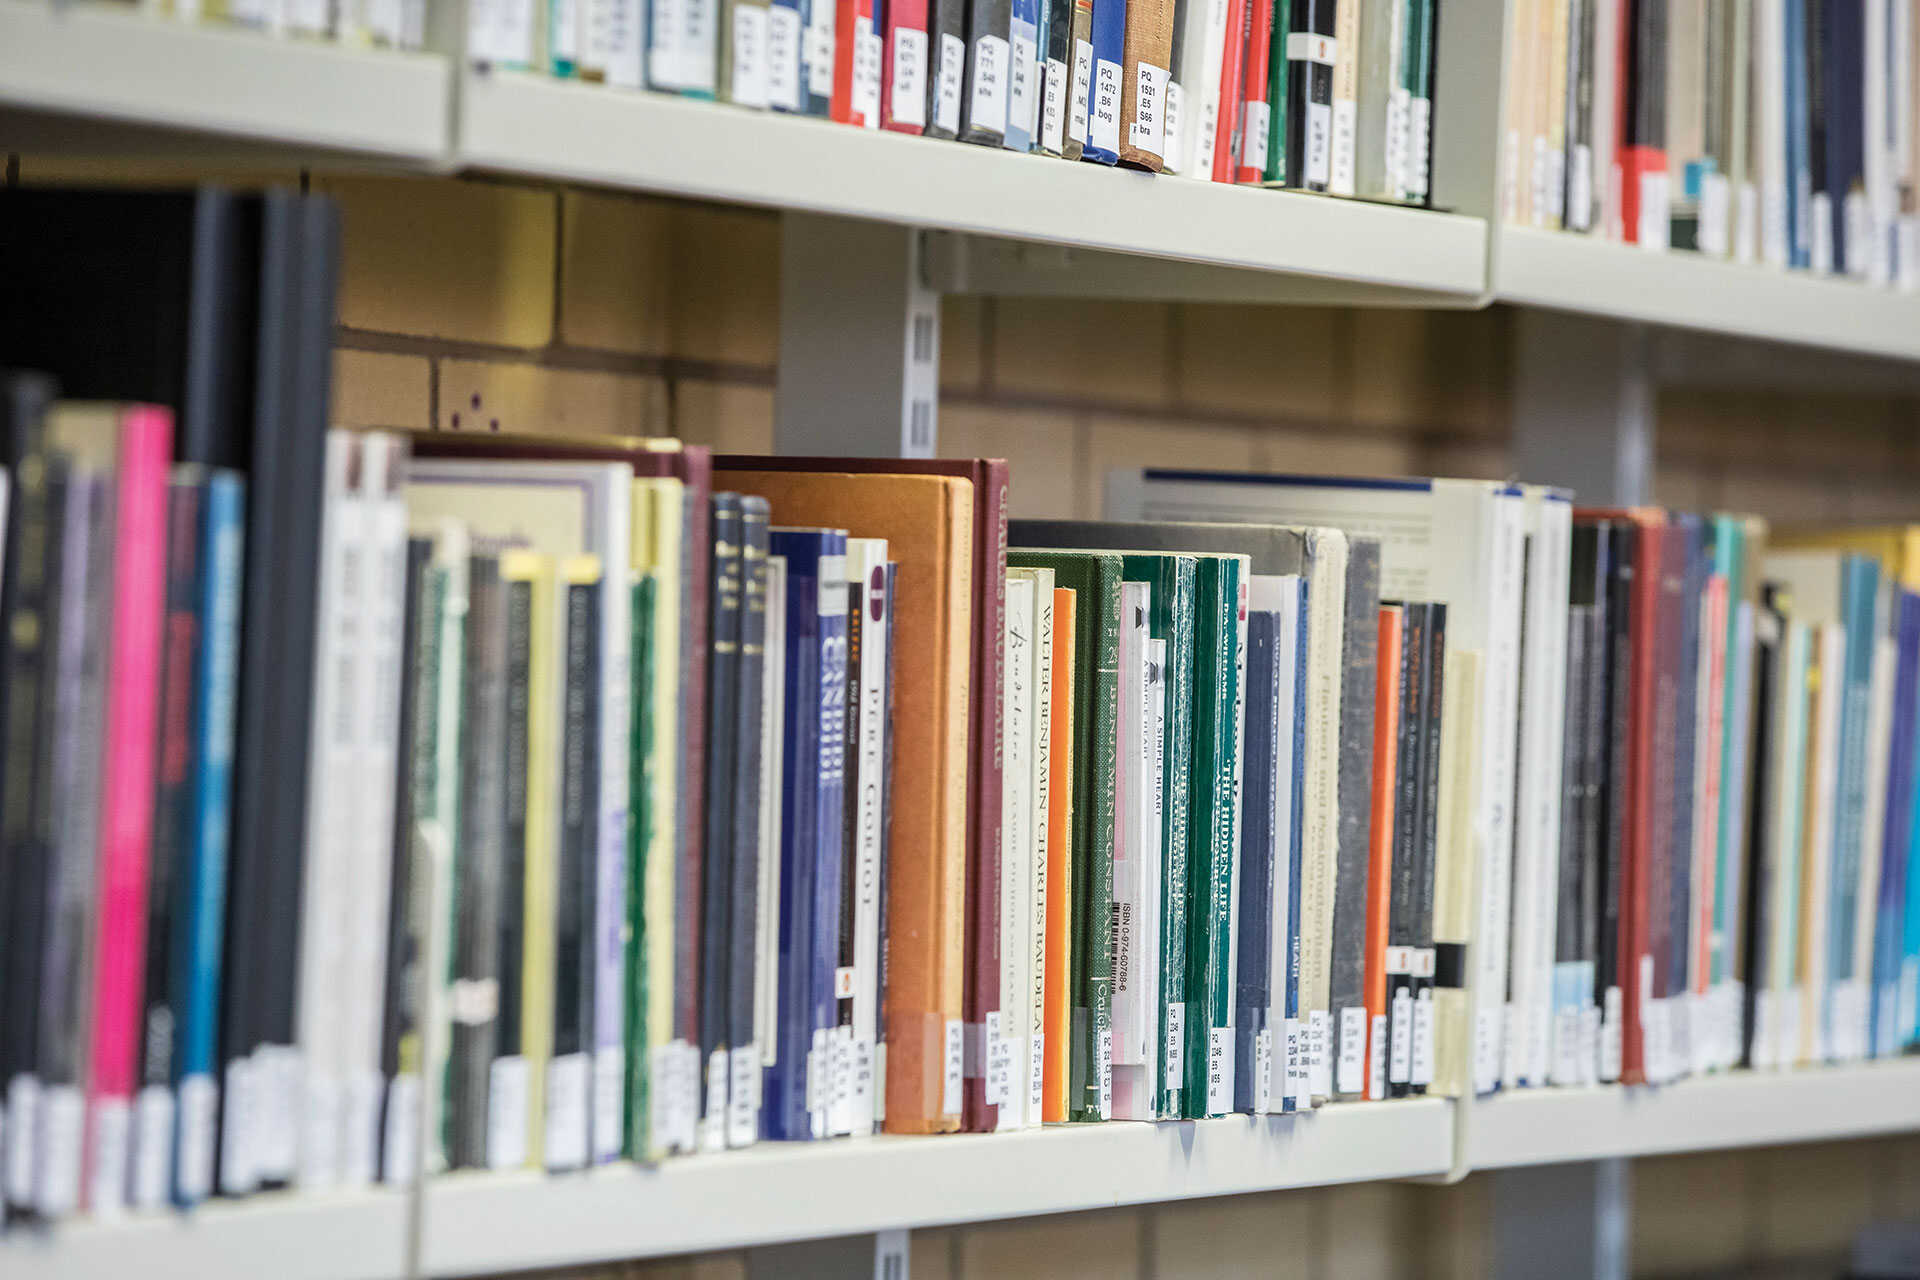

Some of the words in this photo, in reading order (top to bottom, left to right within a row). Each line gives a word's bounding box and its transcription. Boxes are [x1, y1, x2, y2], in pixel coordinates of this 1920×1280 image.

[1048, 61, 1057, 73] PQ
[1079, 57, 1088, 70] PQ
[1100, 67, 1113, 80] PQ
[1141, 70, 1152, 82] PQ
[1099, 81, 1117, 95] 1472
[1099, 95, 1112, 107] .B6
[1140, 84, 1156, 97] 1521
[1098, 109, 1113, 124] bog
[1139, 124, 1151, 136] bra
[996, 485, 1008, 600] CHARLES
[1041, 605, 1052, 694] WALTER
[1221, 630, 1229, 700] WILLIAMS
[994, 605, 1006, 770] BAUDELAIRE
[1320, 675, 1331, 760] Flaubert
[1038, 700, 1049, 810] BENJAMIN
[1107, 685, 1118, 817] BENJAMIN
[1154, 776, 1162, 816] HEART
[1318, 769, 1328, 808] and
[1220, 806, 1230, 875] HIDDEN
[1036, 822, 1047, 926] CHARLES
[1103, 823, 1113, 961] CONSTANT
[1121, 902, 1131, 925] ISBN
[1219, 882, 1228, 921] LIFE
[1313, 813, 1327, 980] Postmodernism
[1119, 927, 1130, 992] 0-974-60788-6
[1292, 935, 1301, 978] HEATH
[1104, 1036, 1111, 1047] PQ
